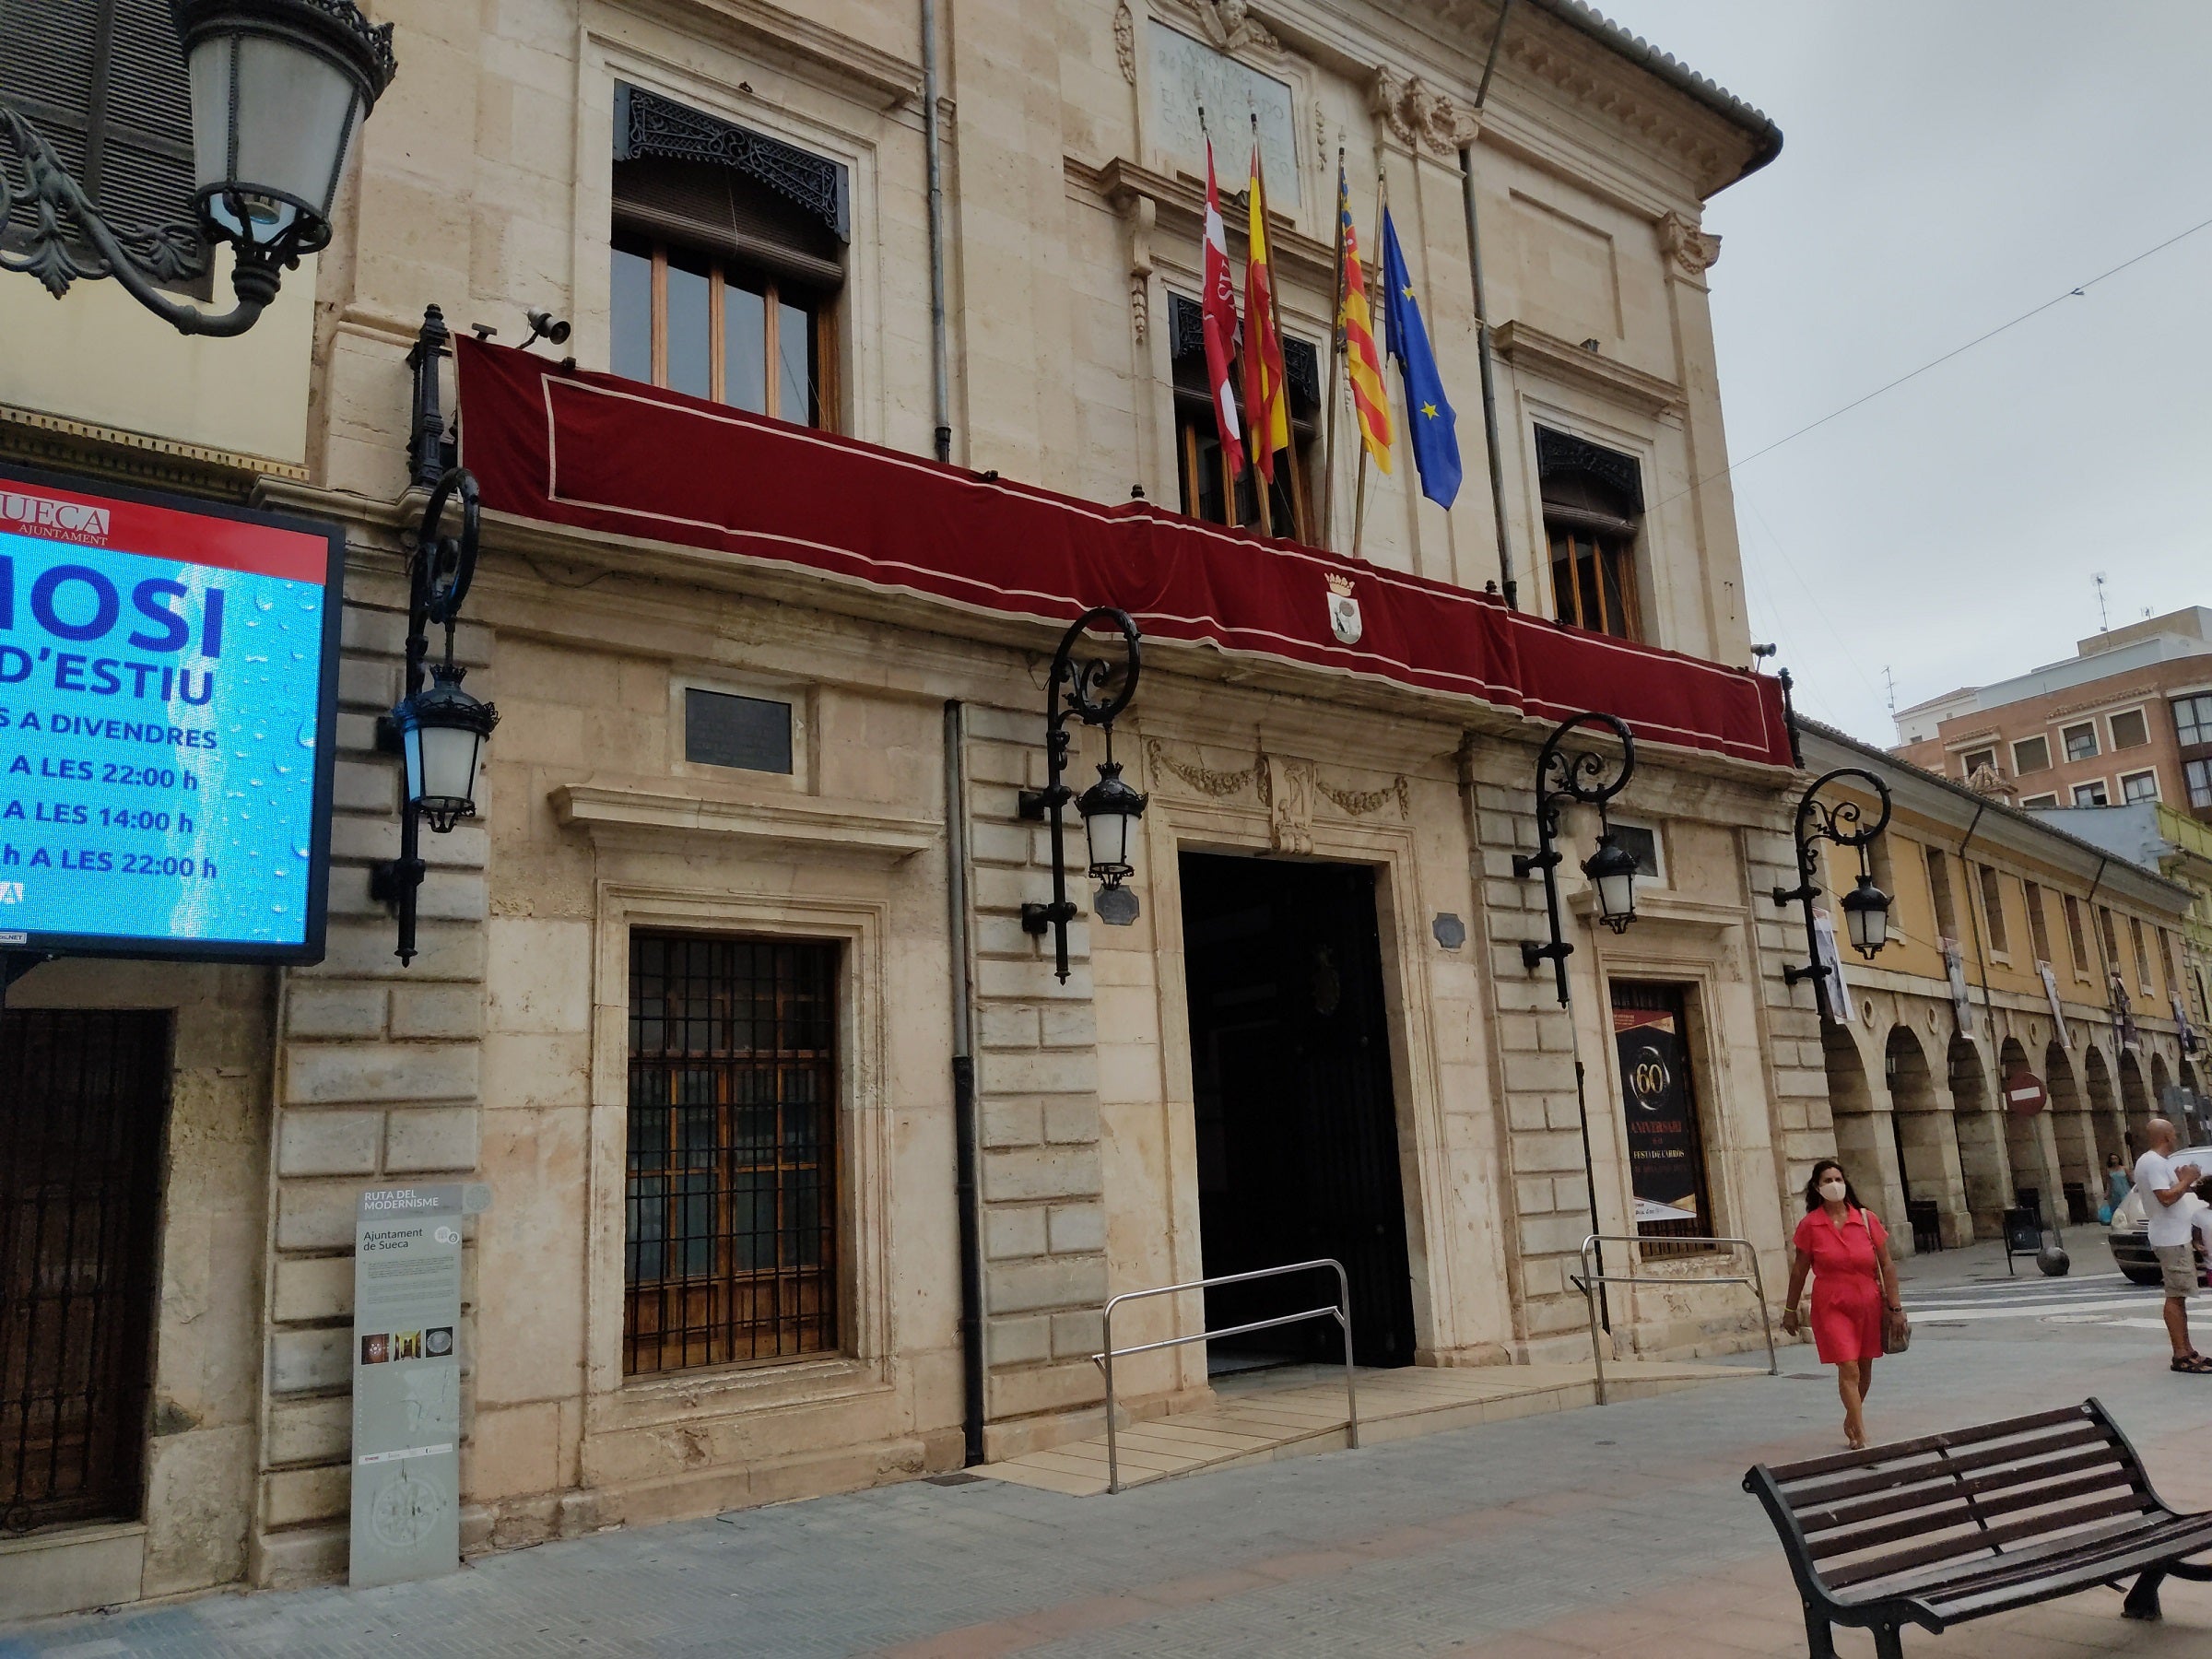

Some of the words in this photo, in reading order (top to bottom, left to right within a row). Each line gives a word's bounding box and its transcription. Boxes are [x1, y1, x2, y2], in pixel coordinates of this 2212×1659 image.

[18, 524, 108, 546] AJUNTAMENT
[18, 711, 41, 731] A
[50, 713, 218, 750] DIVENDRES
[9, 755, 31, 776] A
[41, 757, 93, 782] LES
[101, 763, 175, 789] 22:00
[183, 769, 198, 791] h
[3, 799, 26, 820] A
[35, 802, 88, 825] LES
[99, 807, 171, 831] 14:00
[178, 812, 194, 833] h
[3, 842, 20, 866] h
[29, 847, 52, 868] A
[61, 849, 113, 872] LES
[121, 853, 194, 877] 22:00
[202, 857, 218, 880] h
[1636, 1063, 1664, 1094] 60
[364, 1190, 394, 1201] RUTA
[396, 1189, 417, 1199] DEL
[364, 1196, 440, 1210] MODERNISME
[363, 1229, 423, 1241] Ajuntament
[363, 1241, 376, 1251] de
[379, 1241, 409, 1250] Sueca
